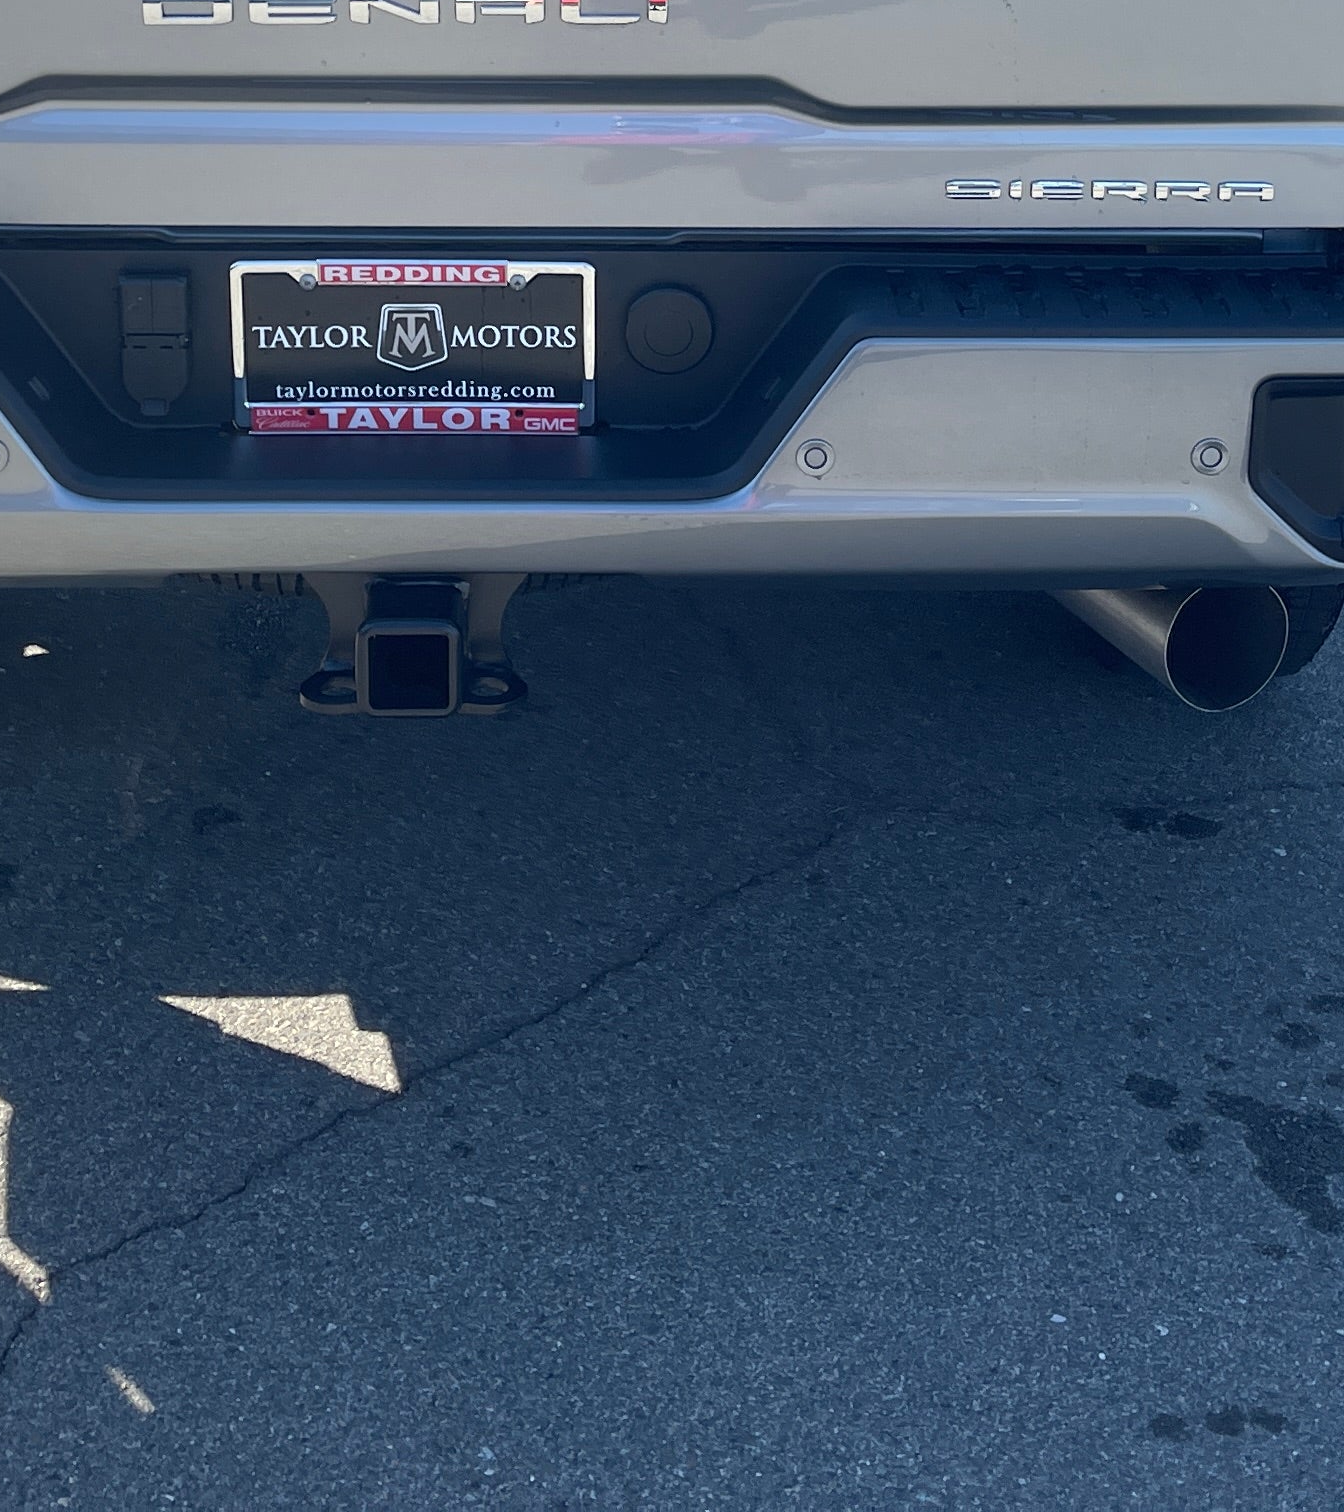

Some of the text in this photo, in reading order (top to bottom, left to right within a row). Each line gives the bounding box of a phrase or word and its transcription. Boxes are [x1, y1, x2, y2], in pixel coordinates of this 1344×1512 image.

[945, 179, 1275, 202] SIERRA
[324, 266, 500, 283] REDDING
[252, 325, 372, 349] TAYLOR
[450, 325, 576, 349] MOTORS
[276, 380, 555, 402] taylormotorsredding.com
[256, 408, 302, 417] BUICK
[319, 407, 509, 430] TAYLOR
[524, 417, 576, 431] GMC
